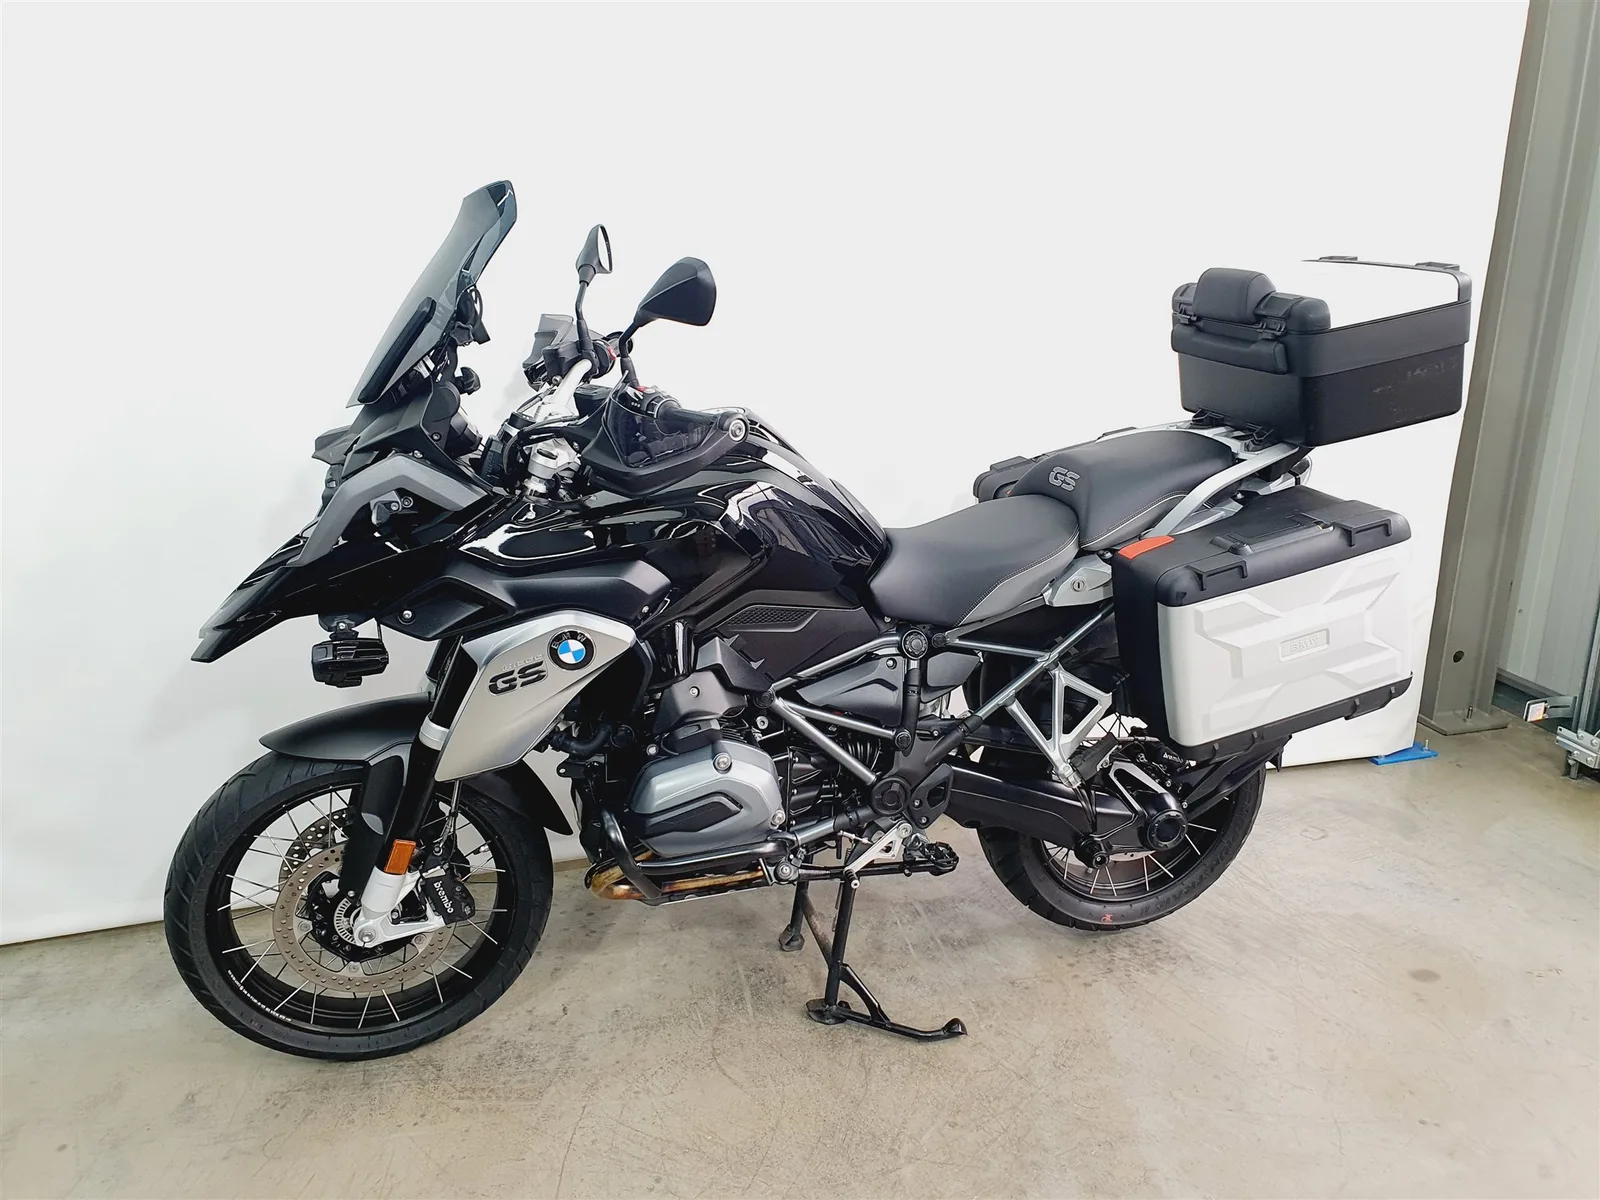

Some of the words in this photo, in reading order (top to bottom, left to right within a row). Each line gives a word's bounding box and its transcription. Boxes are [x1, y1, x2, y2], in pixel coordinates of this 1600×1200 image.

[1048, 466, 1081, 491] GS
[551, 631, 588, 650] BMW
[488, 660, 547, 695] GS
[433, 880, 454, 914] brembo
